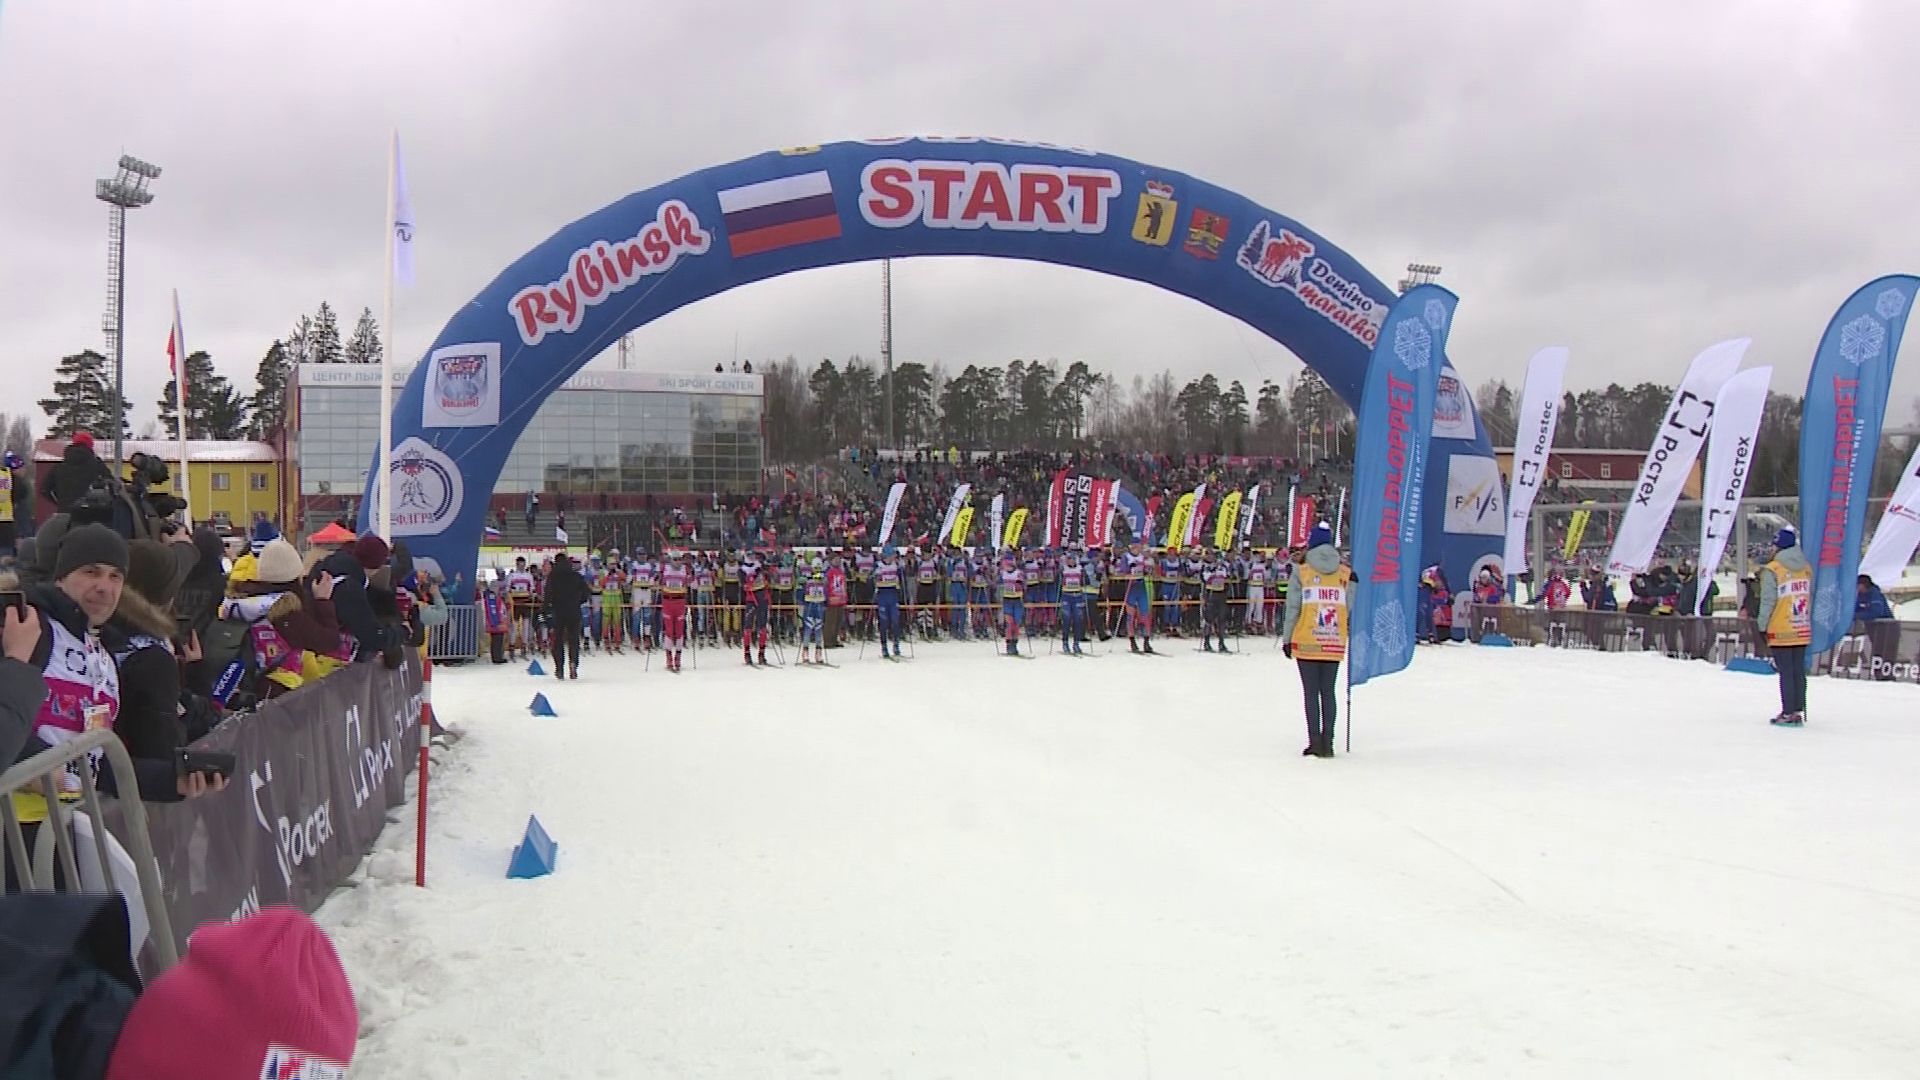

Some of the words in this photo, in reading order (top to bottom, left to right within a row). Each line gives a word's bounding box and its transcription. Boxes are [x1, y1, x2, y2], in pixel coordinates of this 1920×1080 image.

[866, 163, 1115, 228] START
[513, 202, 705, 340] Rybinsk
[1310, 260, 1373, 312] Demino
[1299, 283, 1378, 348] maratho
[1533, 400, 1553, 455] Rostec
[1371, 371, 1415, 584] WORLDLOPPET
[1635, 434, 1679, 507] Ростех
[1725, 436, 1750, 501] Ростех
[1093, 487, 1106, 540] ATOMIC
[1318, 587, 1340, 600] INFO
[1871, 655, 1920, 680] Росте
